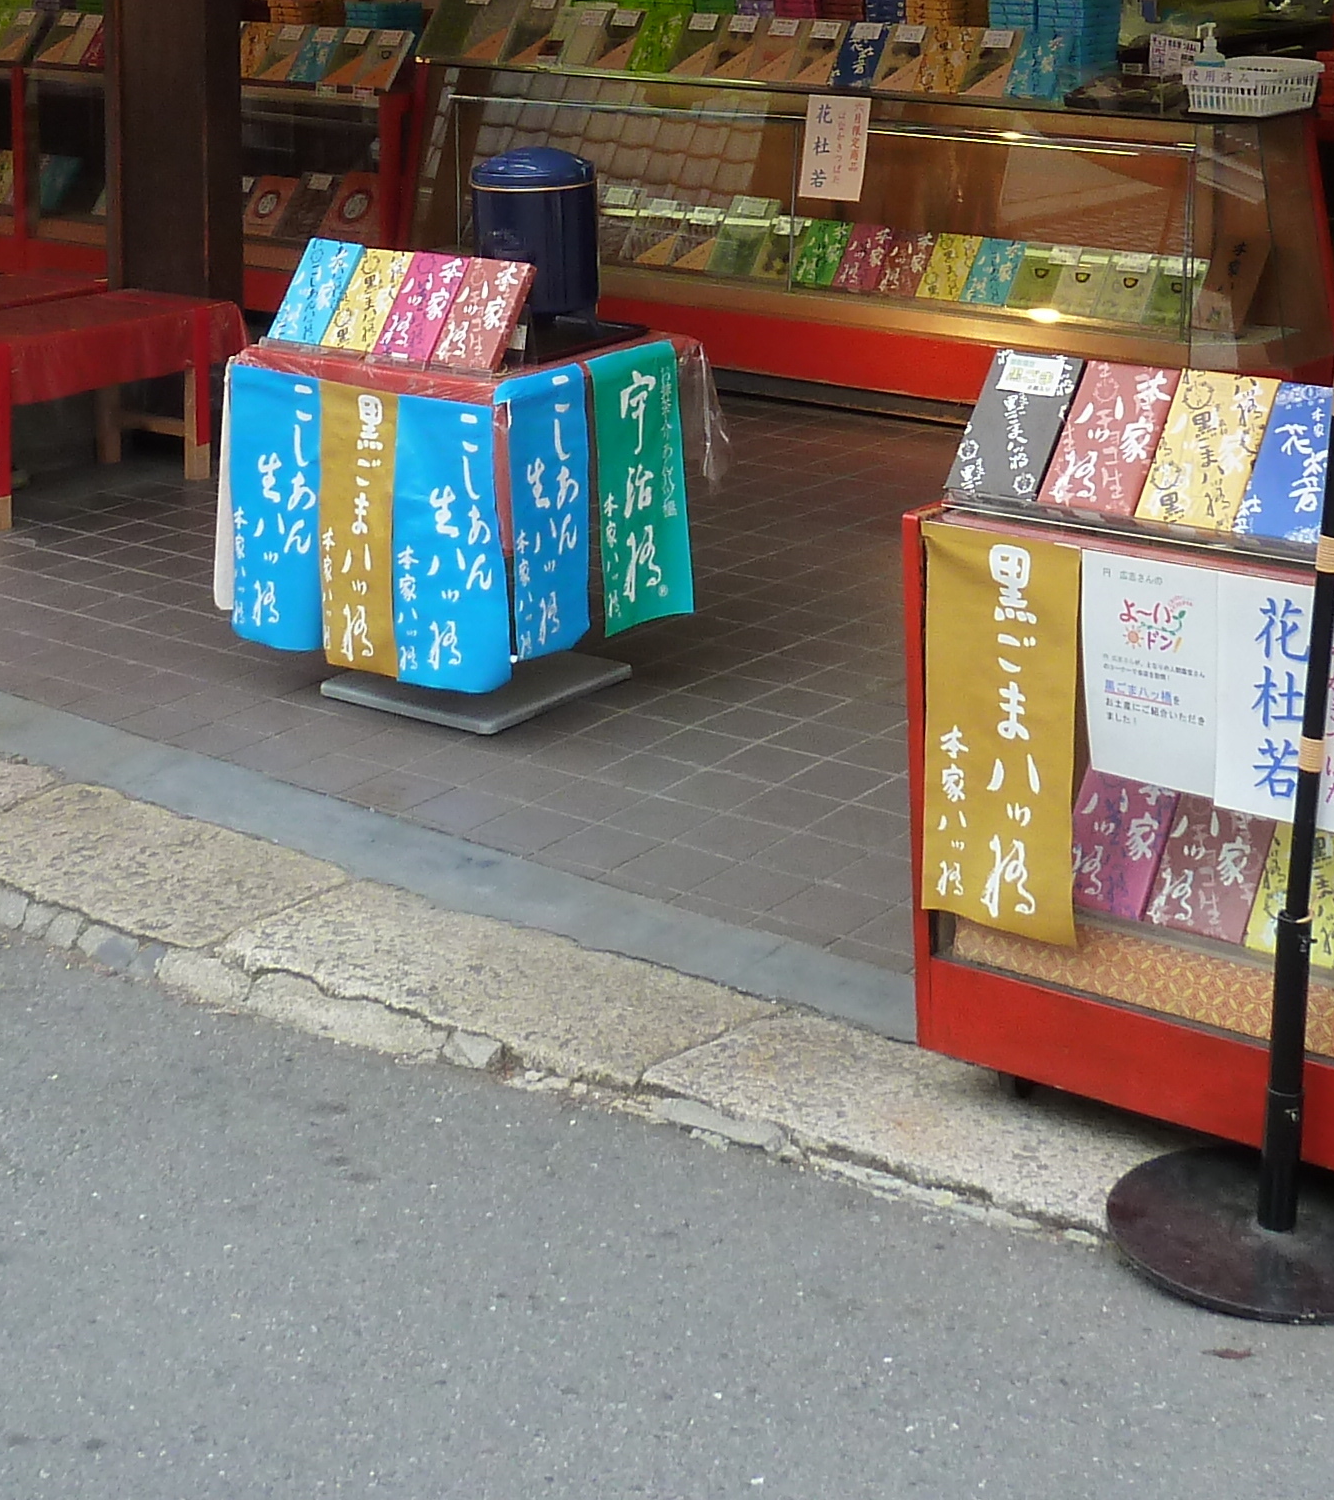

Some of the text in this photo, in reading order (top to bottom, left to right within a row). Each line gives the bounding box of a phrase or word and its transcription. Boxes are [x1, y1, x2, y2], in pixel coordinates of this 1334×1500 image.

[810, 103, 834, 188] 花杜若
[425, 257, 464, 322] 本家
[482, 261, 519, 331] 本家
[250, 451, 286, 628] 生八ツ橋
[283, 383, 317, 554] こしあん
[339, 393, 385, 662] 黒ごま八ツ橋
[459, 412, 494, 591] こしあん
[551, 373, 580, 555] こしあん
[619, 369, 662, 604] 宇治橋
[426, 484, 467, 672] 生八ツ橋
[980, 542, 1042, 919] 黒ごま八ツ橋
[1251, 596, 1311, 799] 花杜若
